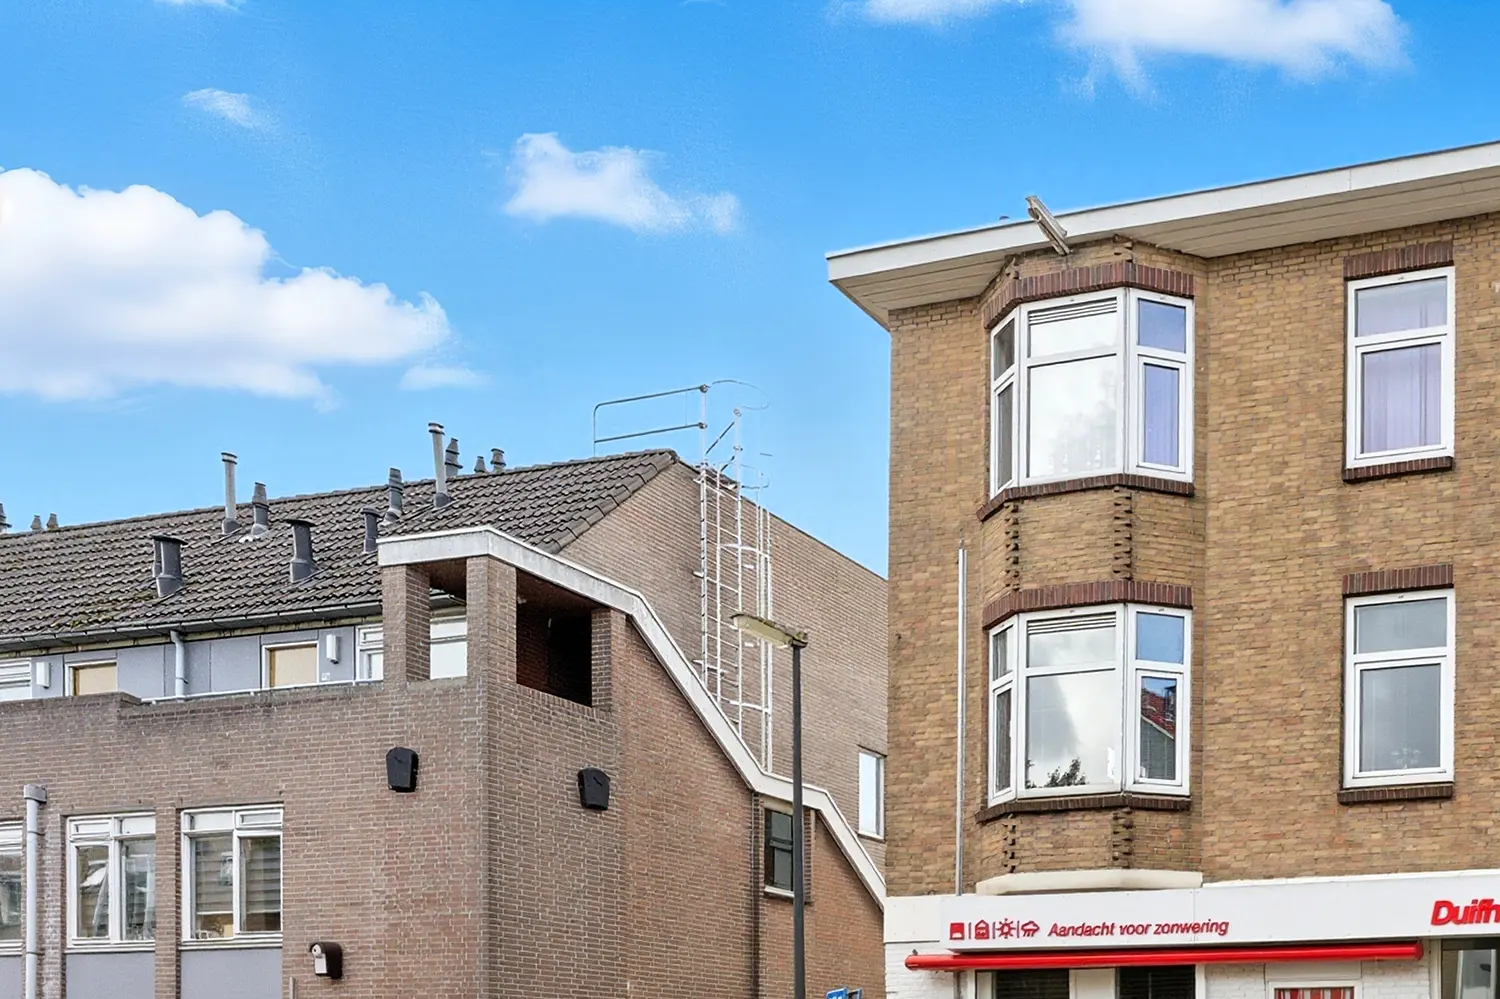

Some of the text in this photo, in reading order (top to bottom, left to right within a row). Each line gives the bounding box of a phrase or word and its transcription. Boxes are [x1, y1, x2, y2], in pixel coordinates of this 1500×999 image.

[1047, 918, 1230, 937] Aandacht voor zonwering
